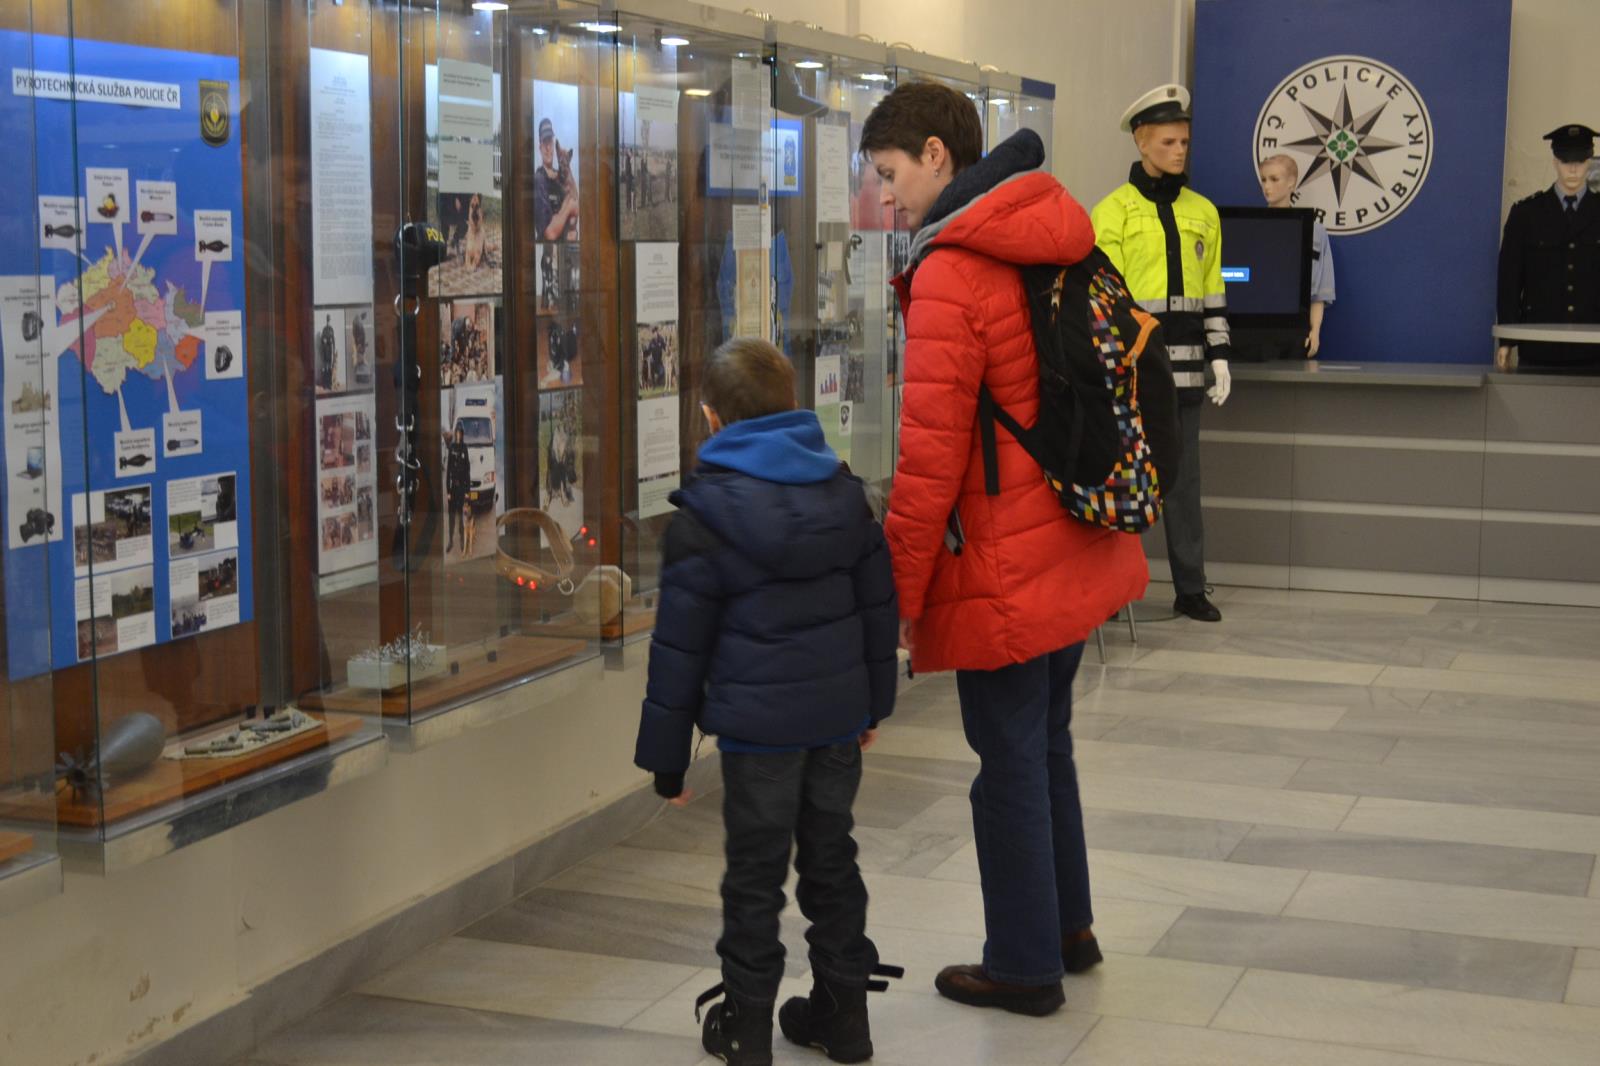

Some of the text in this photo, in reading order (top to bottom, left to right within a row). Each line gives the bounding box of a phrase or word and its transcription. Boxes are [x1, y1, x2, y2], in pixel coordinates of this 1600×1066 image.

[16, 75, 178, 103] PYROTECHNICKÁ SLUŽBA POLICIE ČR
[1285, 65, 1402, 102] POLICIE
[1262, 112, 1423, 226] ČEÉ REPUBLIKY
